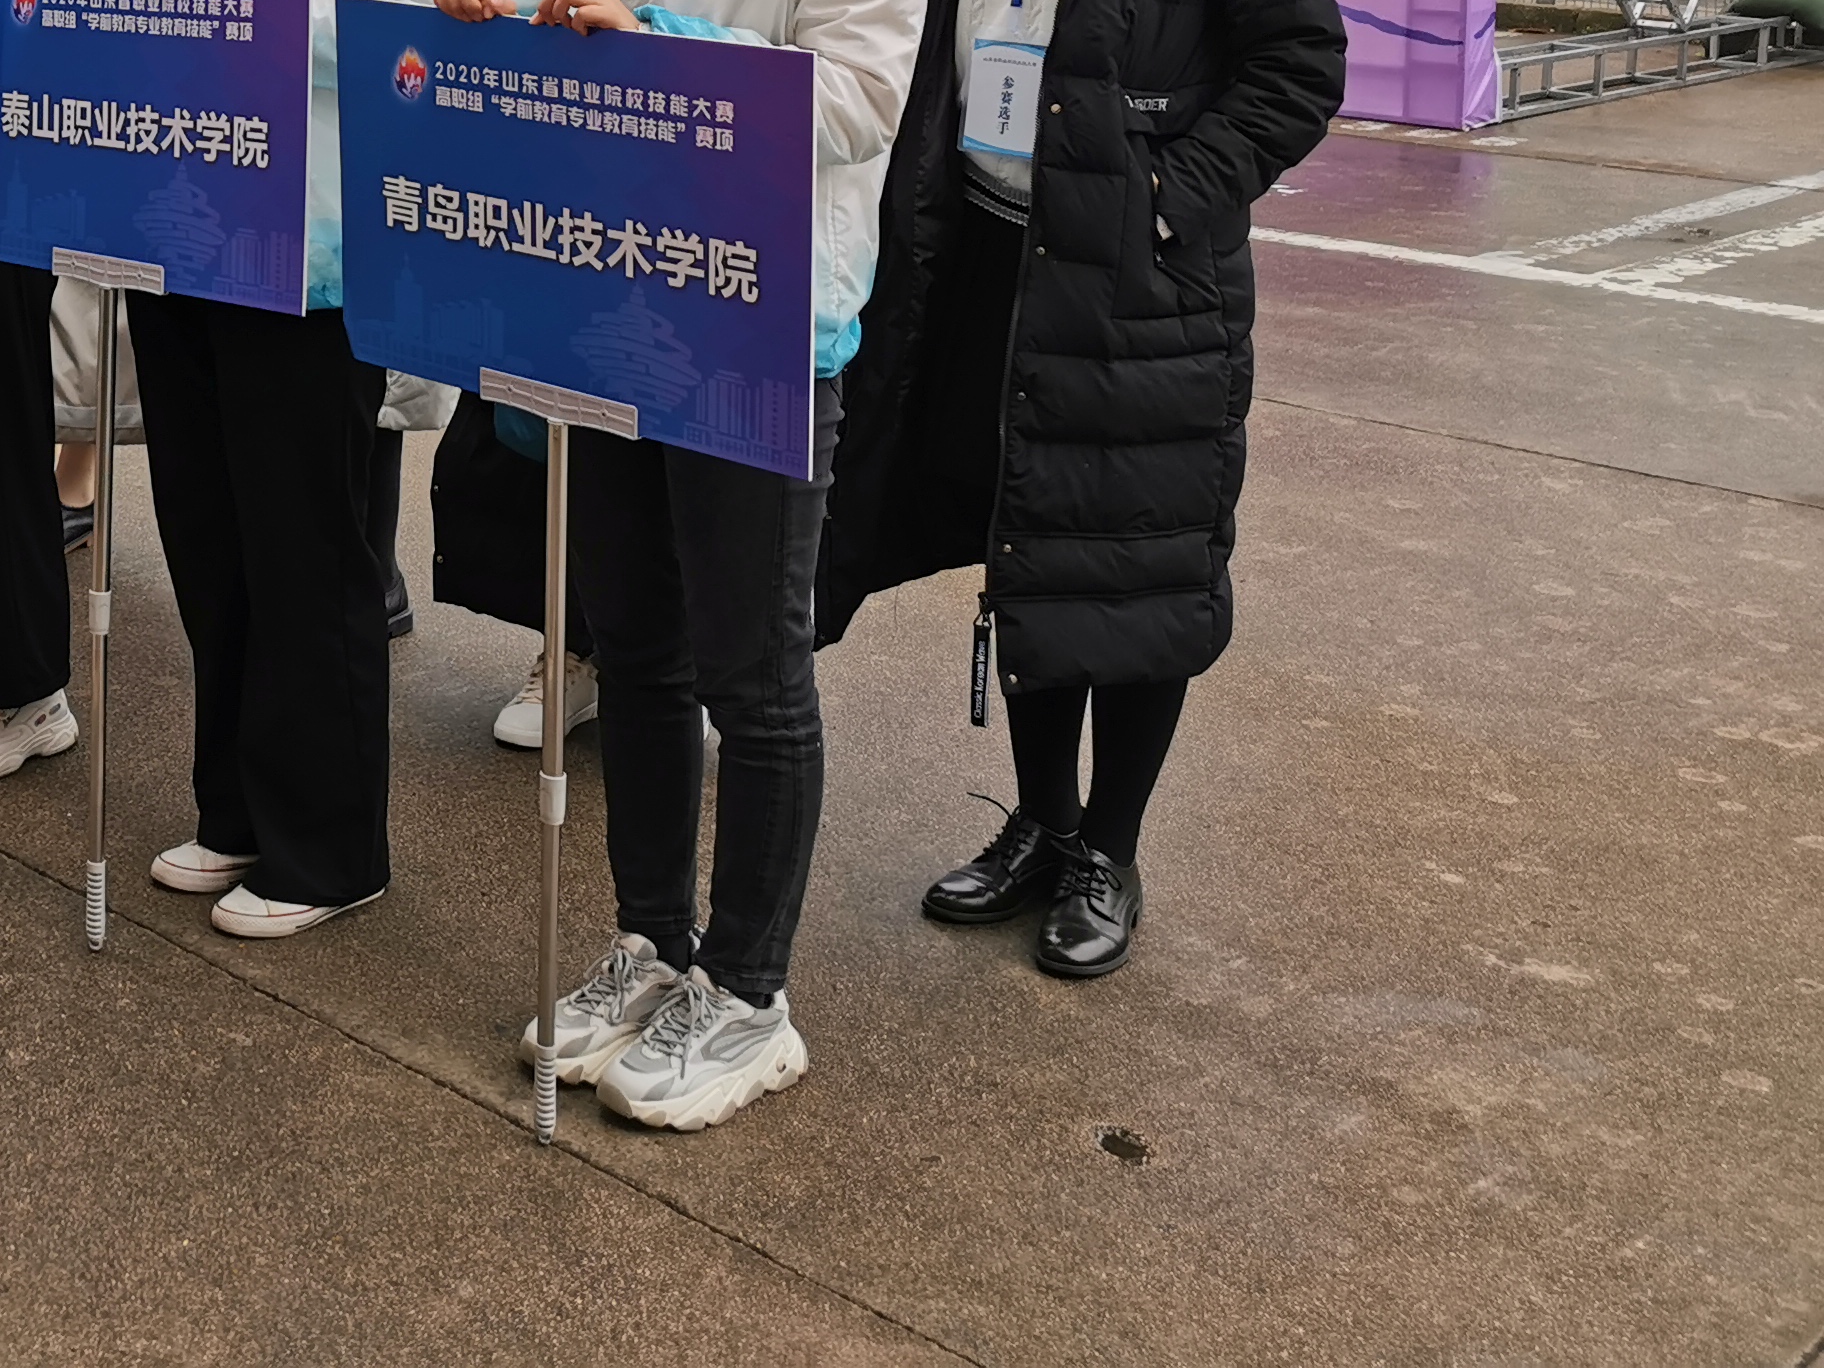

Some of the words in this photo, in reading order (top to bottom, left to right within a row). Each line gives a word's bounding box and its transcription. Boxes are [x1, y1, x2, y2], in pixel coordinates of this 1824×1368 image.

[434, 60, 736, 124] 2020年山东省职业院校技能大赛
[0, 89, 270, 169] 泰山职业技术学院
[381, 174, 760, 304] 青岛职业技术学院
[974, 663, 986, 692] Korean
